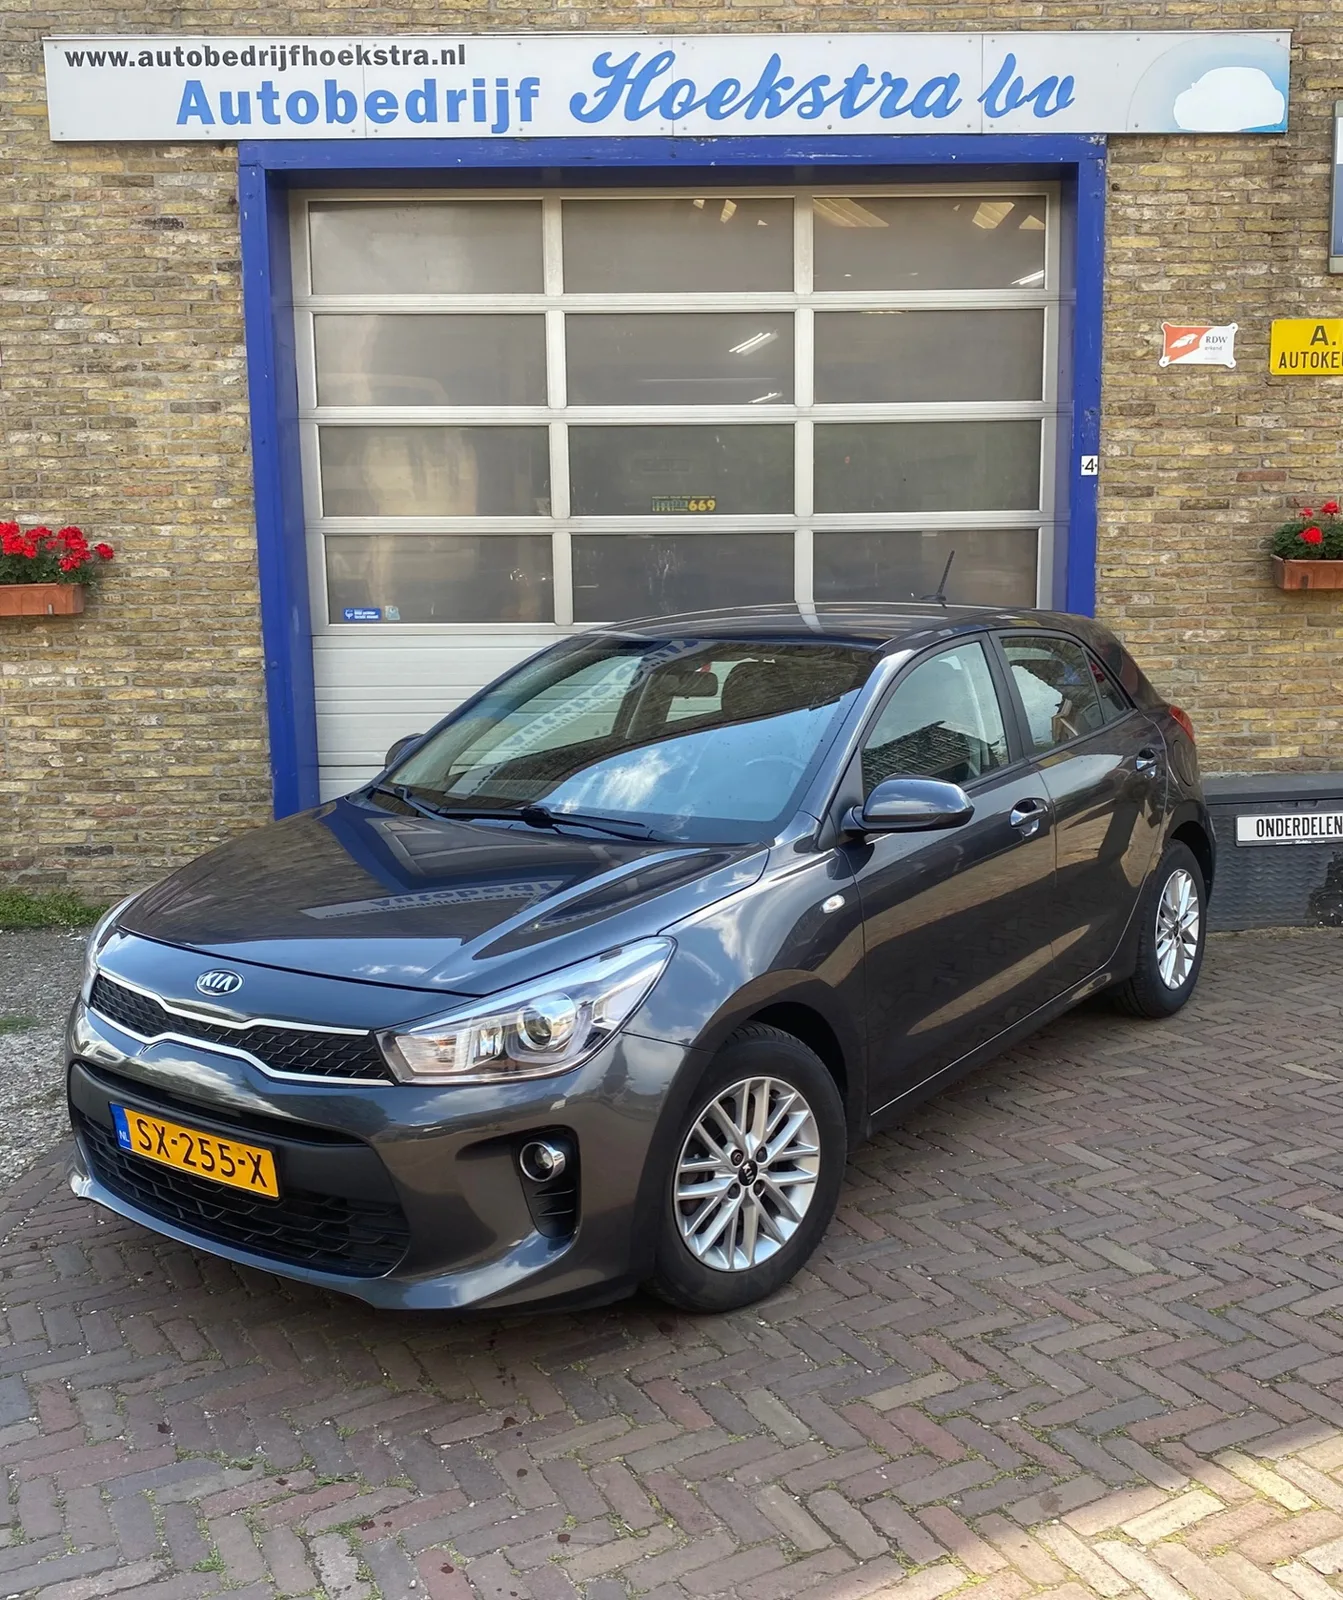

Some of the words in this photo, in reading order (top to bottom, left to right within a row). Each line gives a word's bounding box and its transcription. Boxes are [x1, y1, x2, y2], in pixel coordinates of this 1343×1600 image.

[65, 44, 465, 72] www.autobedrijfhoekstra.nl
[176, 77, 540, 134] Autobedrijf
[568, 50, 962, 124] Hoekstra
[977, 52, 1076, 119] bv
[1205, 335, 1228, 344] RDW
[1278, 351, 1343, 369] AUTOKE
[1084, 457, 1095, 473] 4
[688, 499, 716, 512] 669
[1256, 815, 1343, 837] ONDERDELEN
[200, 972, 235, 991] KIA
[118, 1129, 131, 1143] NL
[136, 1118, 268, 1188] SX-255-X
